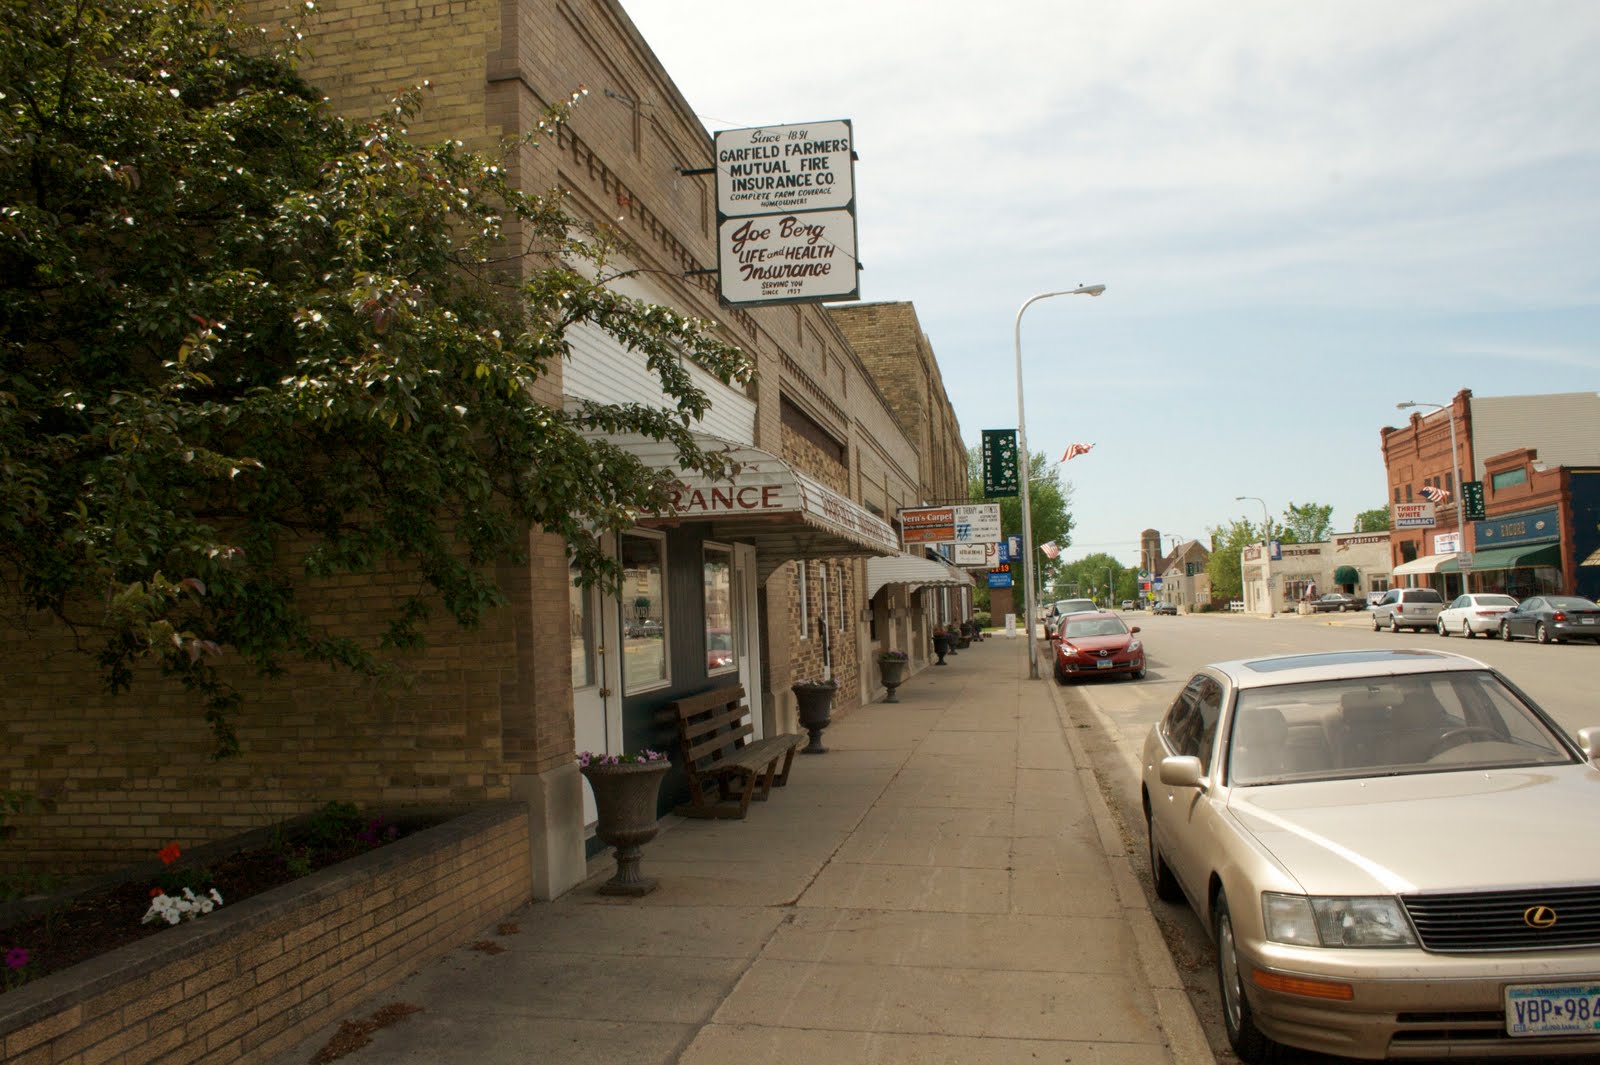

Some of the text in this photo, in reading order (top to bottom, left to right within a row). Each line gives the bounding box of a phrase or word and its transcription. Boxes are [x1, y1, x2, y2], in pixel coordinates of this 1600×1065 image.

[750, 130, 809, 144] Since 1891
[719, 139, 848, 162] GARFIELD FARMERS
[730, 156, 829, 178] MUTUAL FIRE
[731, 172, 836, 192] INSURANCE CO.
[730, 188, 832, 202] COMPLETE FARM COVERAGE
[760, 198, 808, 208] HOMEOWNERS
[732, 216, 826, 254] Joe Berg
[738, 245, 836, 264] LIFE and HEALTH
[739, 262, 832, 282] Insurance
[761, 281, 789, 290] SERVING
[984, 436, 993, 485] FERTILE
[902, 514, 926, 523] Vern's
[927, 513, 952, 522] Carpet
